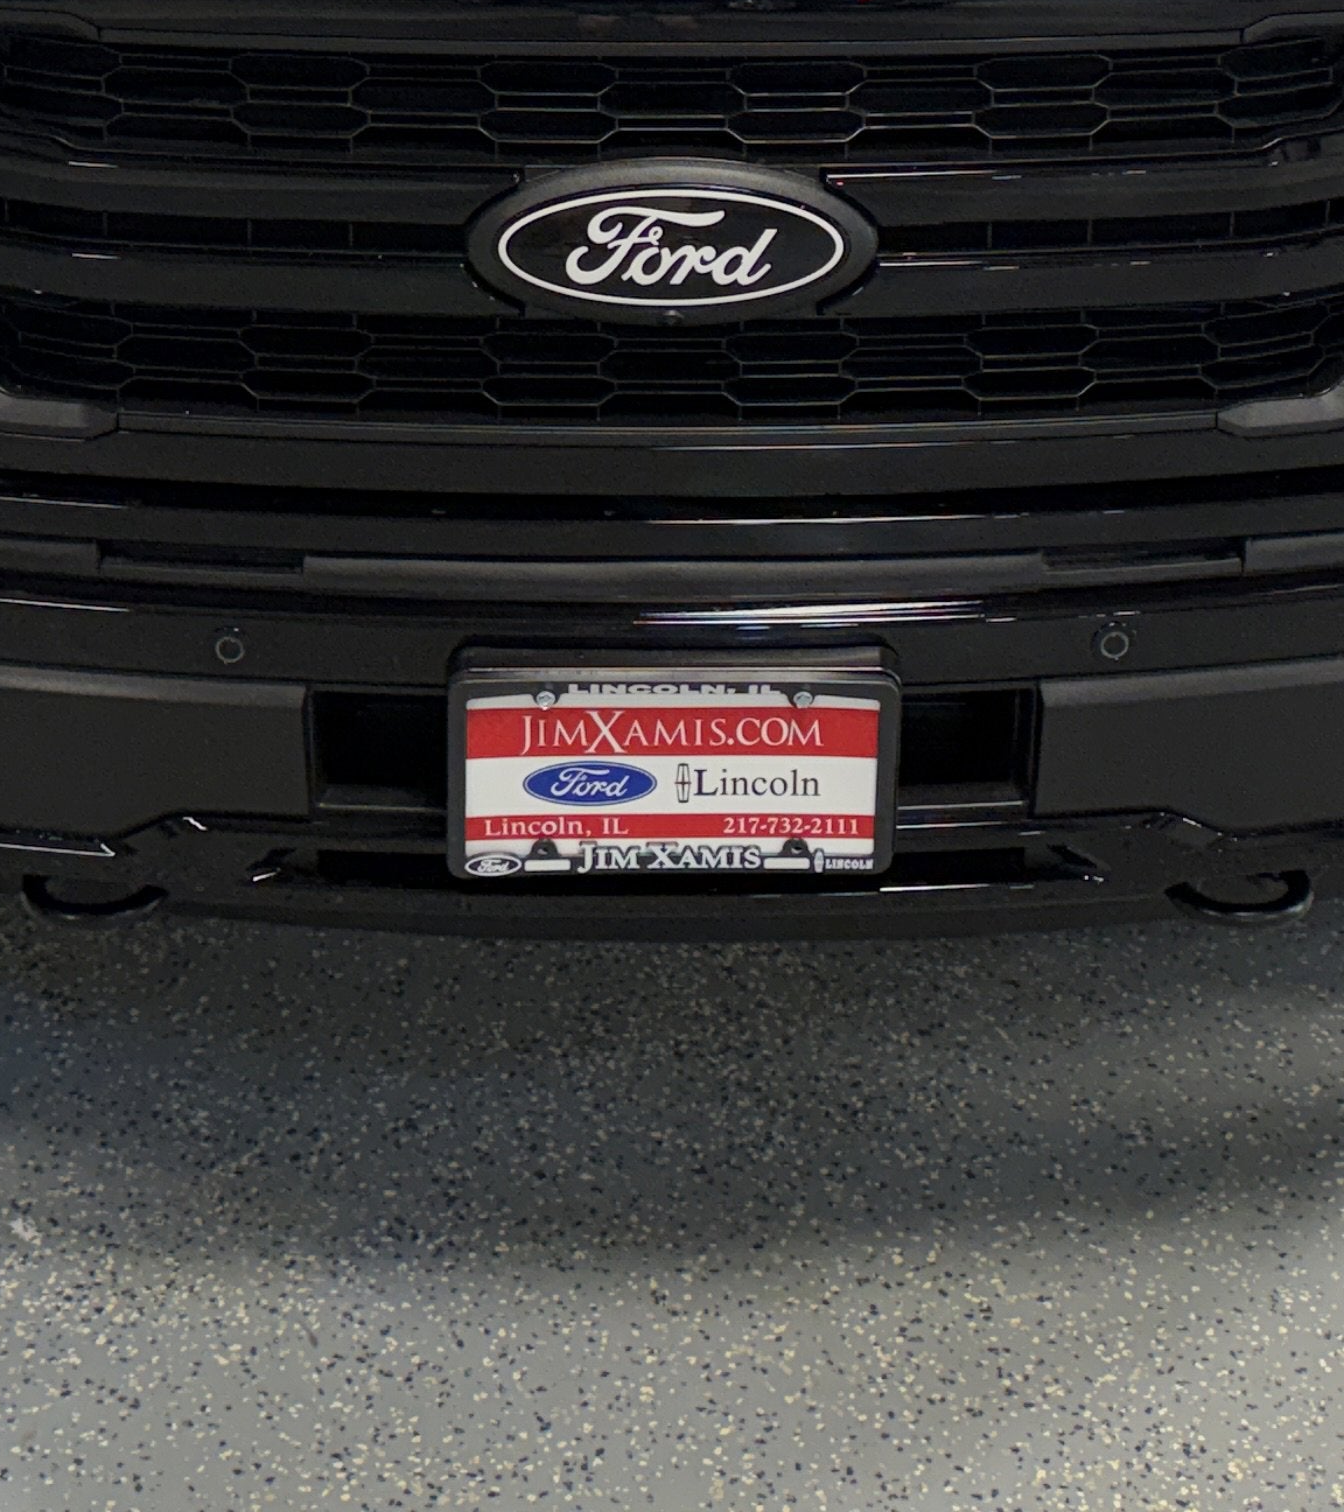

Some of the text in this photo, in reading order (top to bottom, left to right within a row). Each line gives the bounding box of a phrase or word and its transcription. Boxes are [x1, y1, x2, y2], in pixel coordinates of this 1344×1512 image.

[565, 206, 778, 286] Ford
[550, 767, 630, 797] Ford
[693, 768, 821, 797] Lincoln
[484, 817, 630, 837] Lincoln, IL
[722, 816, 859, 835] 217-732-2111
[477, 859, 511, 874] Ford
[576, 841, 762, 874] JIM XAMIS
[824, 858, 874, 870] LINCOLN
